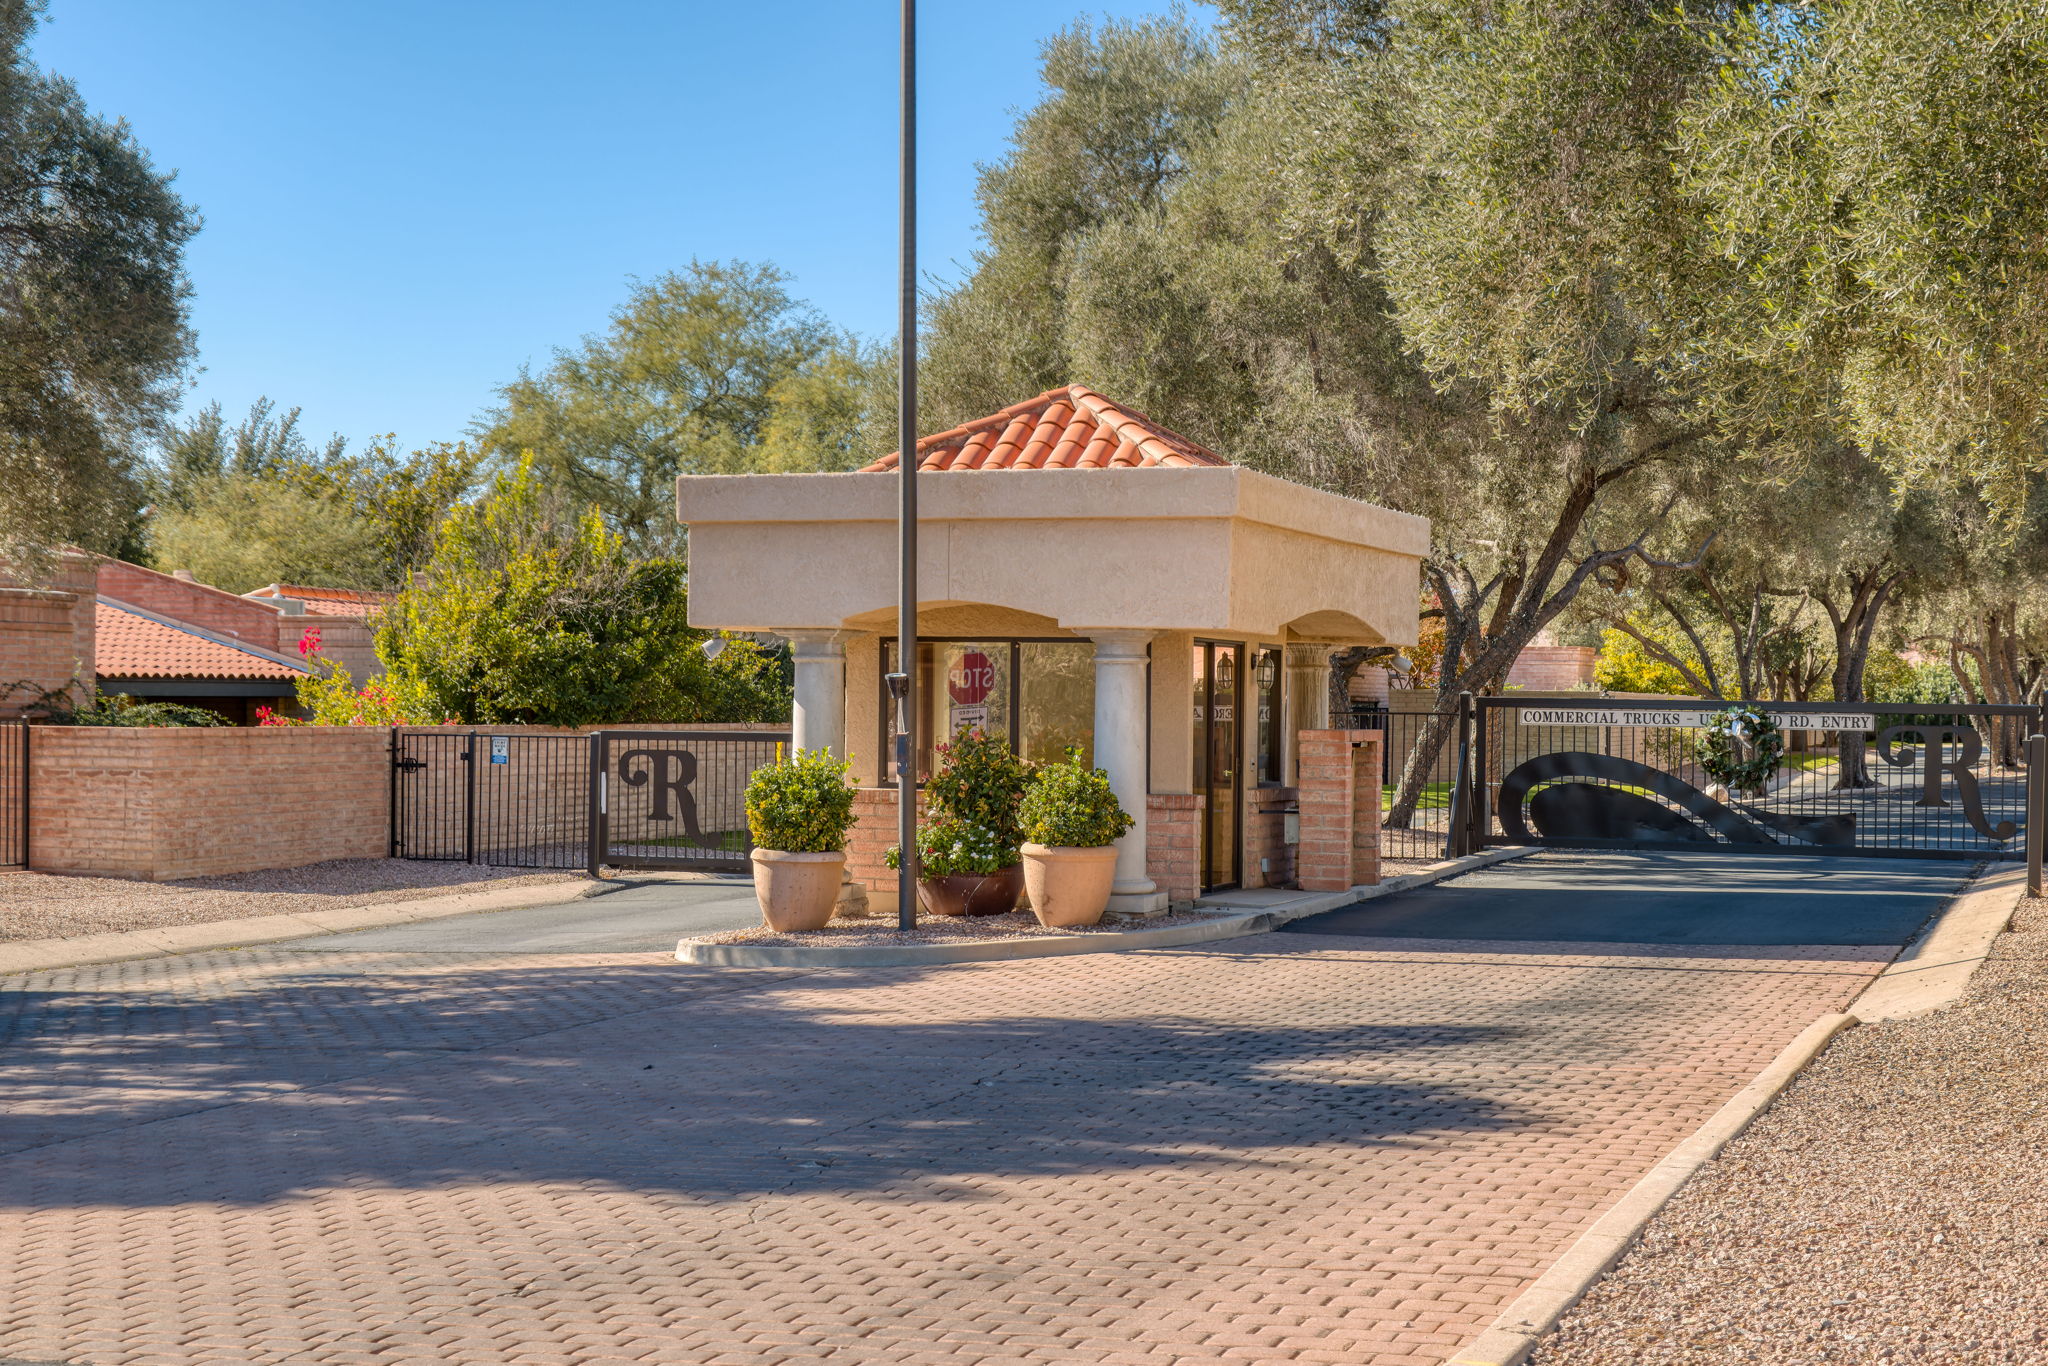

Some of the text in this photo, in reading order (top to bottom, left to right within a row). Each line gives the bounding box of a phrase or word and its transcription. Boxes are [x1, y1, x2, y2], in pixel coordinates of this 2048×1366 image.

[1523, 710, 1618, 725] COMMERCIAL
[1623, 712, 1681, 725] TRUCKS
[1789, 715, 1814, 729] RD.
[1821, 715, 1871, 729] ENTRY
